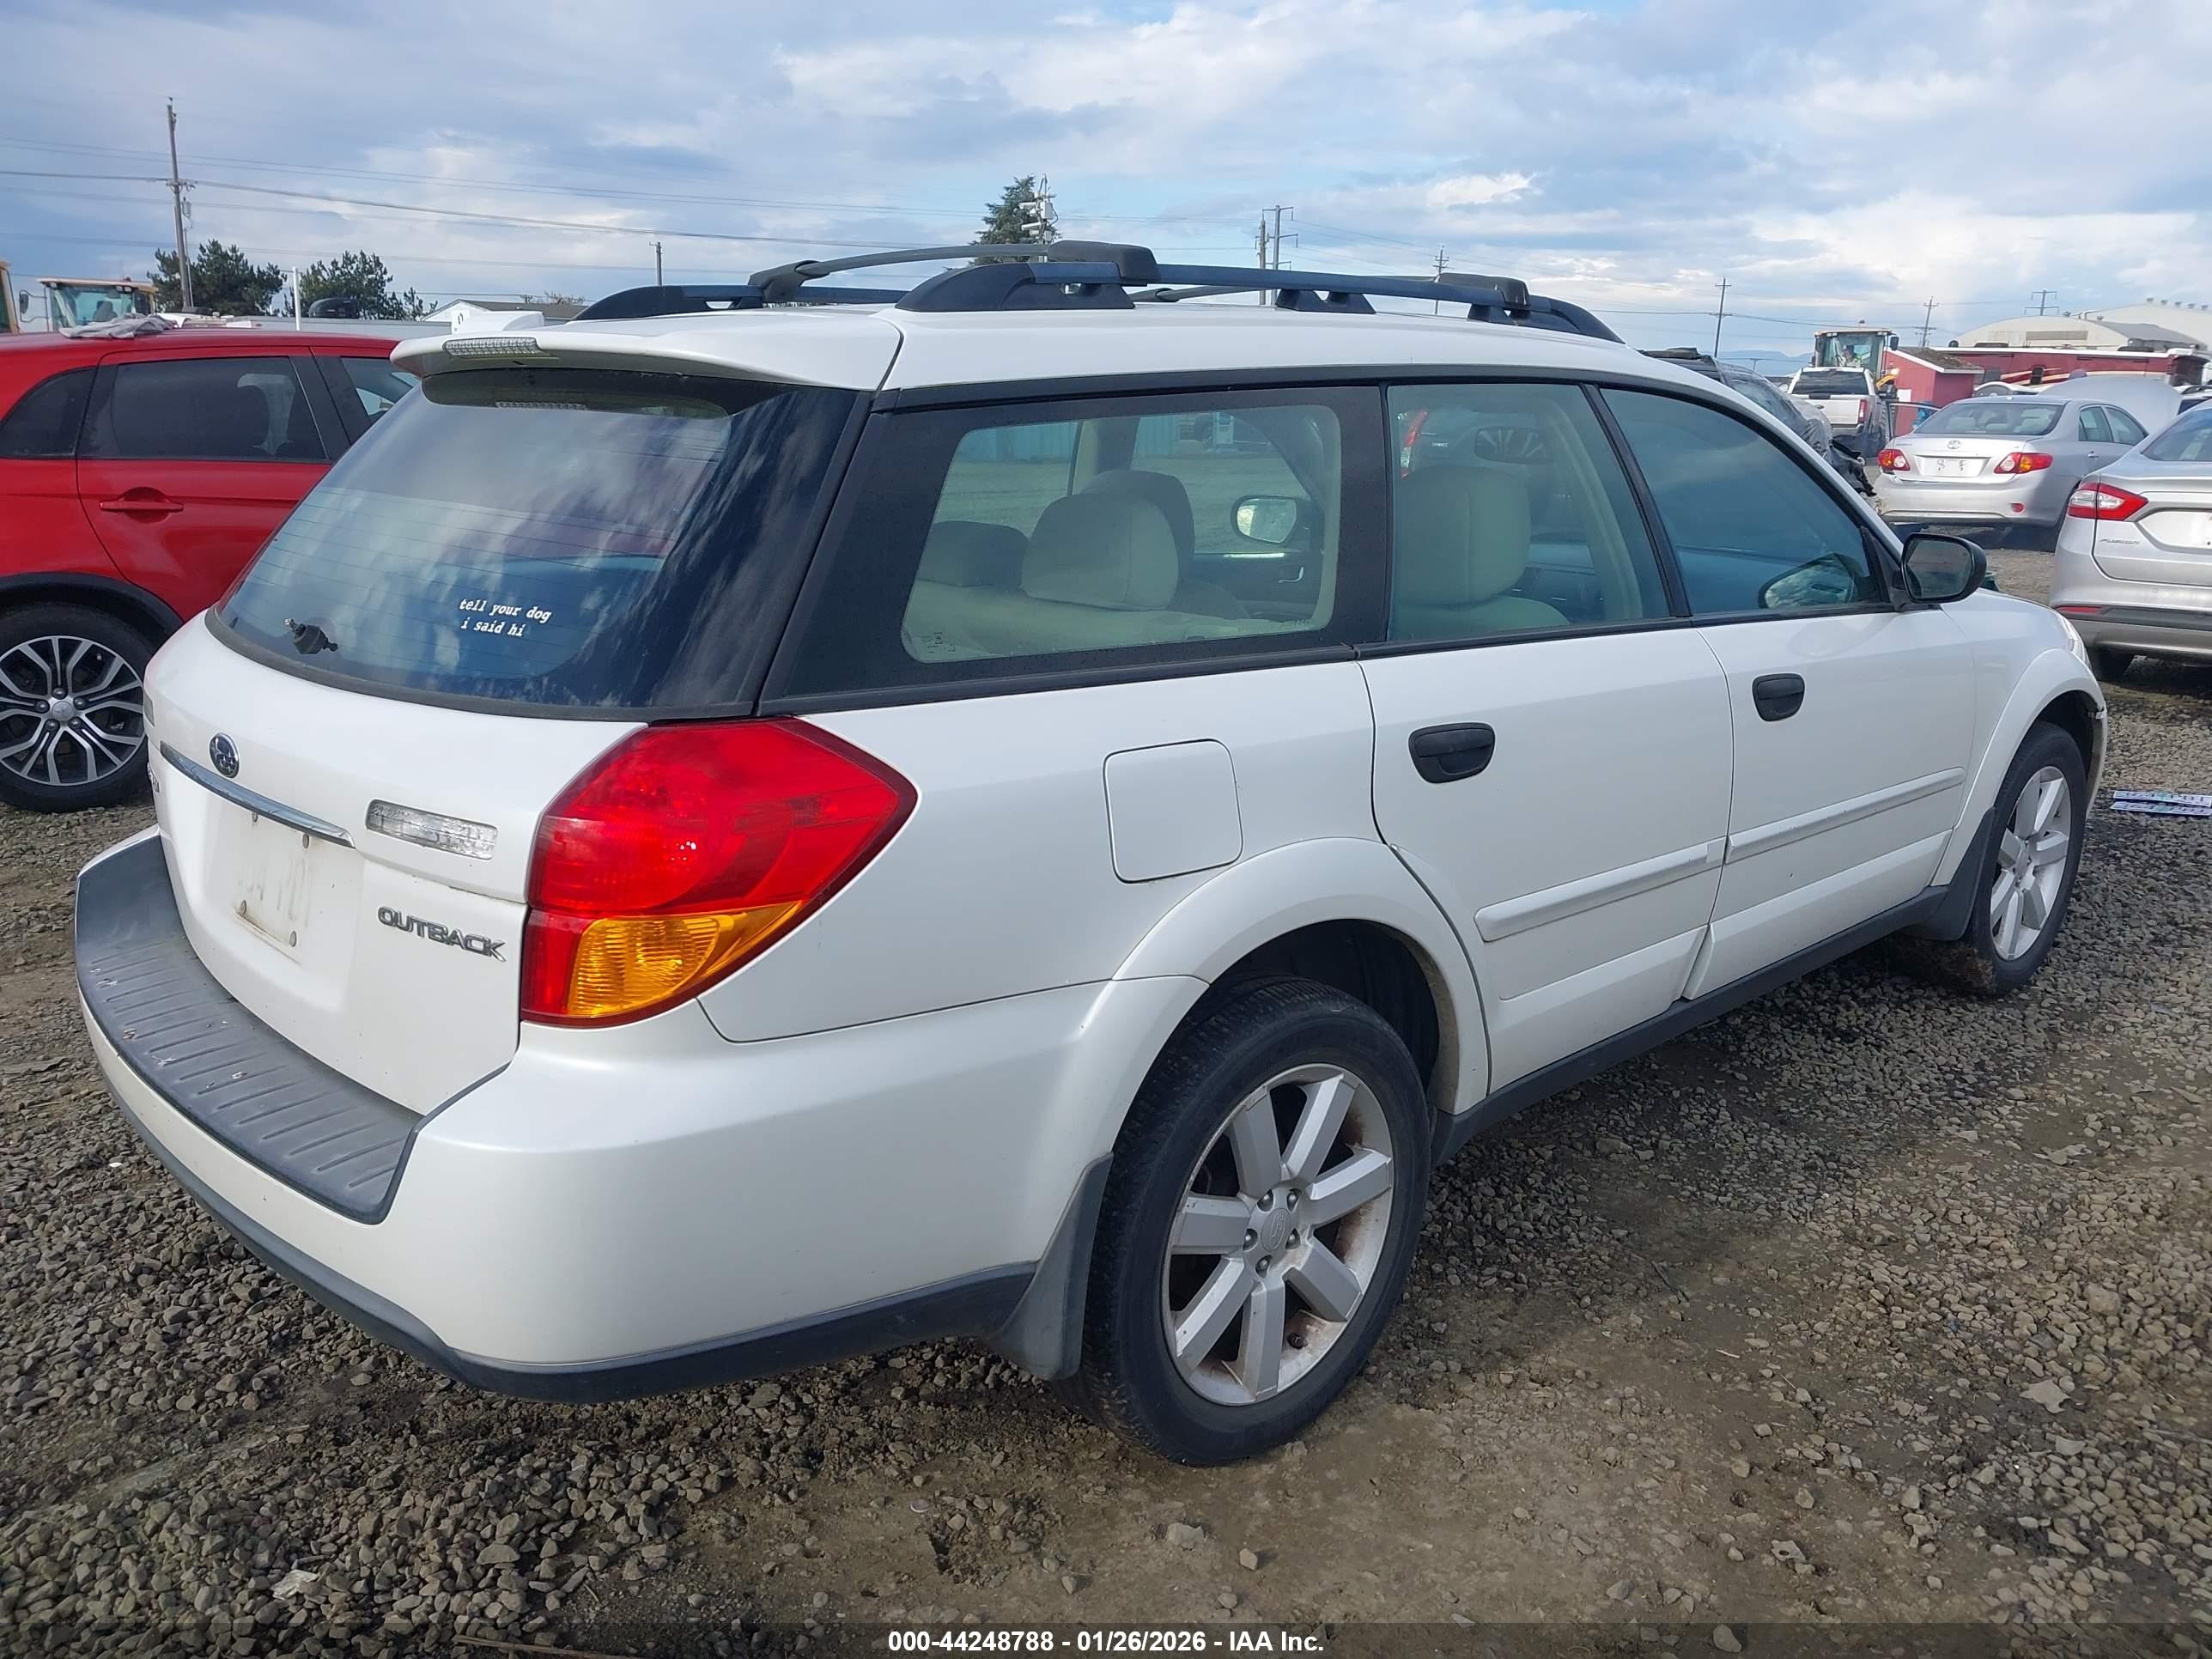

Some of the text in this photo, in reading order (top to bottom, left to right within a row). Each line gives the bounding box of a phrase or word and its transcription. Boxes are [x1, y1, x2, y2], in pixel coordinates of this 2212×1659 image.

[459, 599, 551, 623] tell your dog
[461, 617, 526, 636] i said hi
[378, 906, 507, 962] OUTBACK
